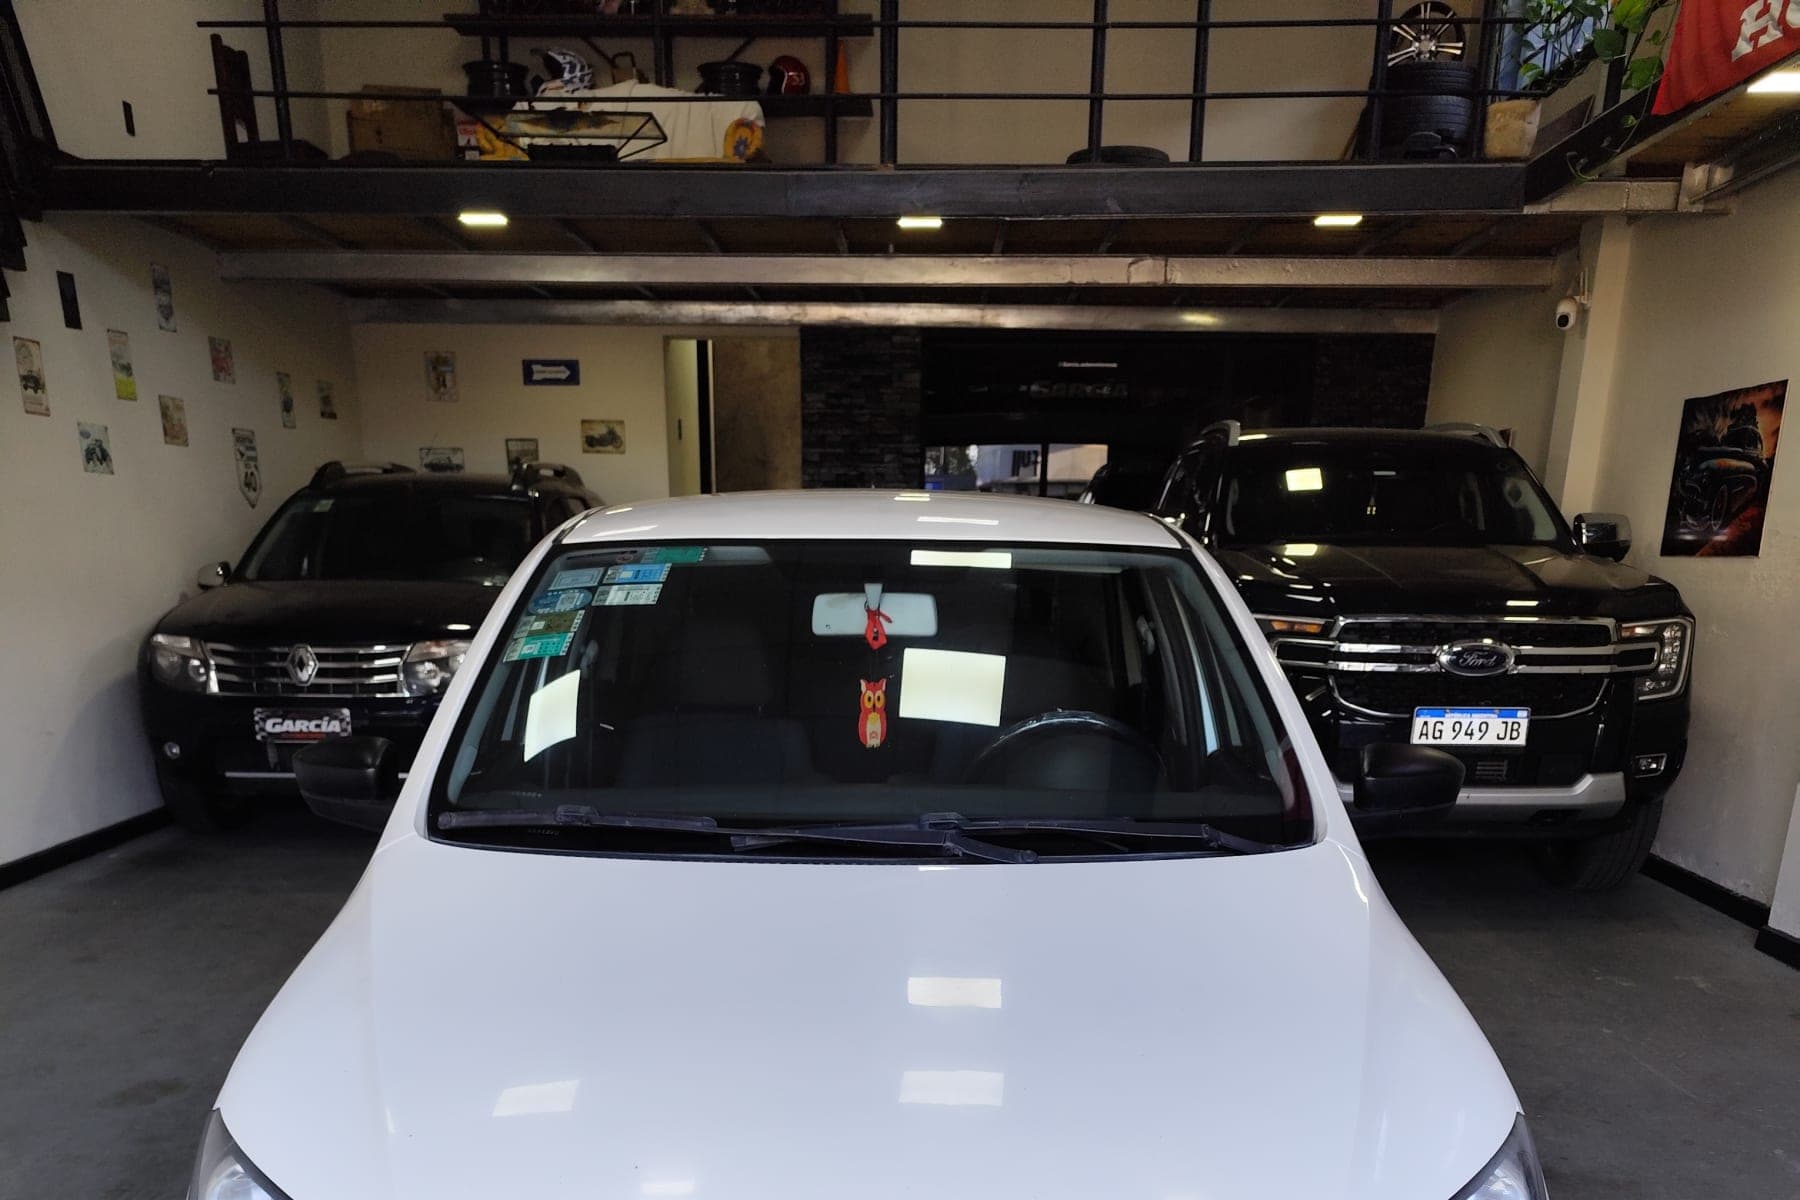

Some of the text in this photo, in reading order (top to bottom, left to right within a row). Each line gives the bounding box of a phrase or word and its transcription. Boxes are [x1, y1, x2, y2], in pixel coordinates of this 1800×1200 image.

[1459, 650, 1498, 667] Ford
[265, 716, 341, 733] GARCÍA
[1419, 721, 1522, 741] AG 949 JB
